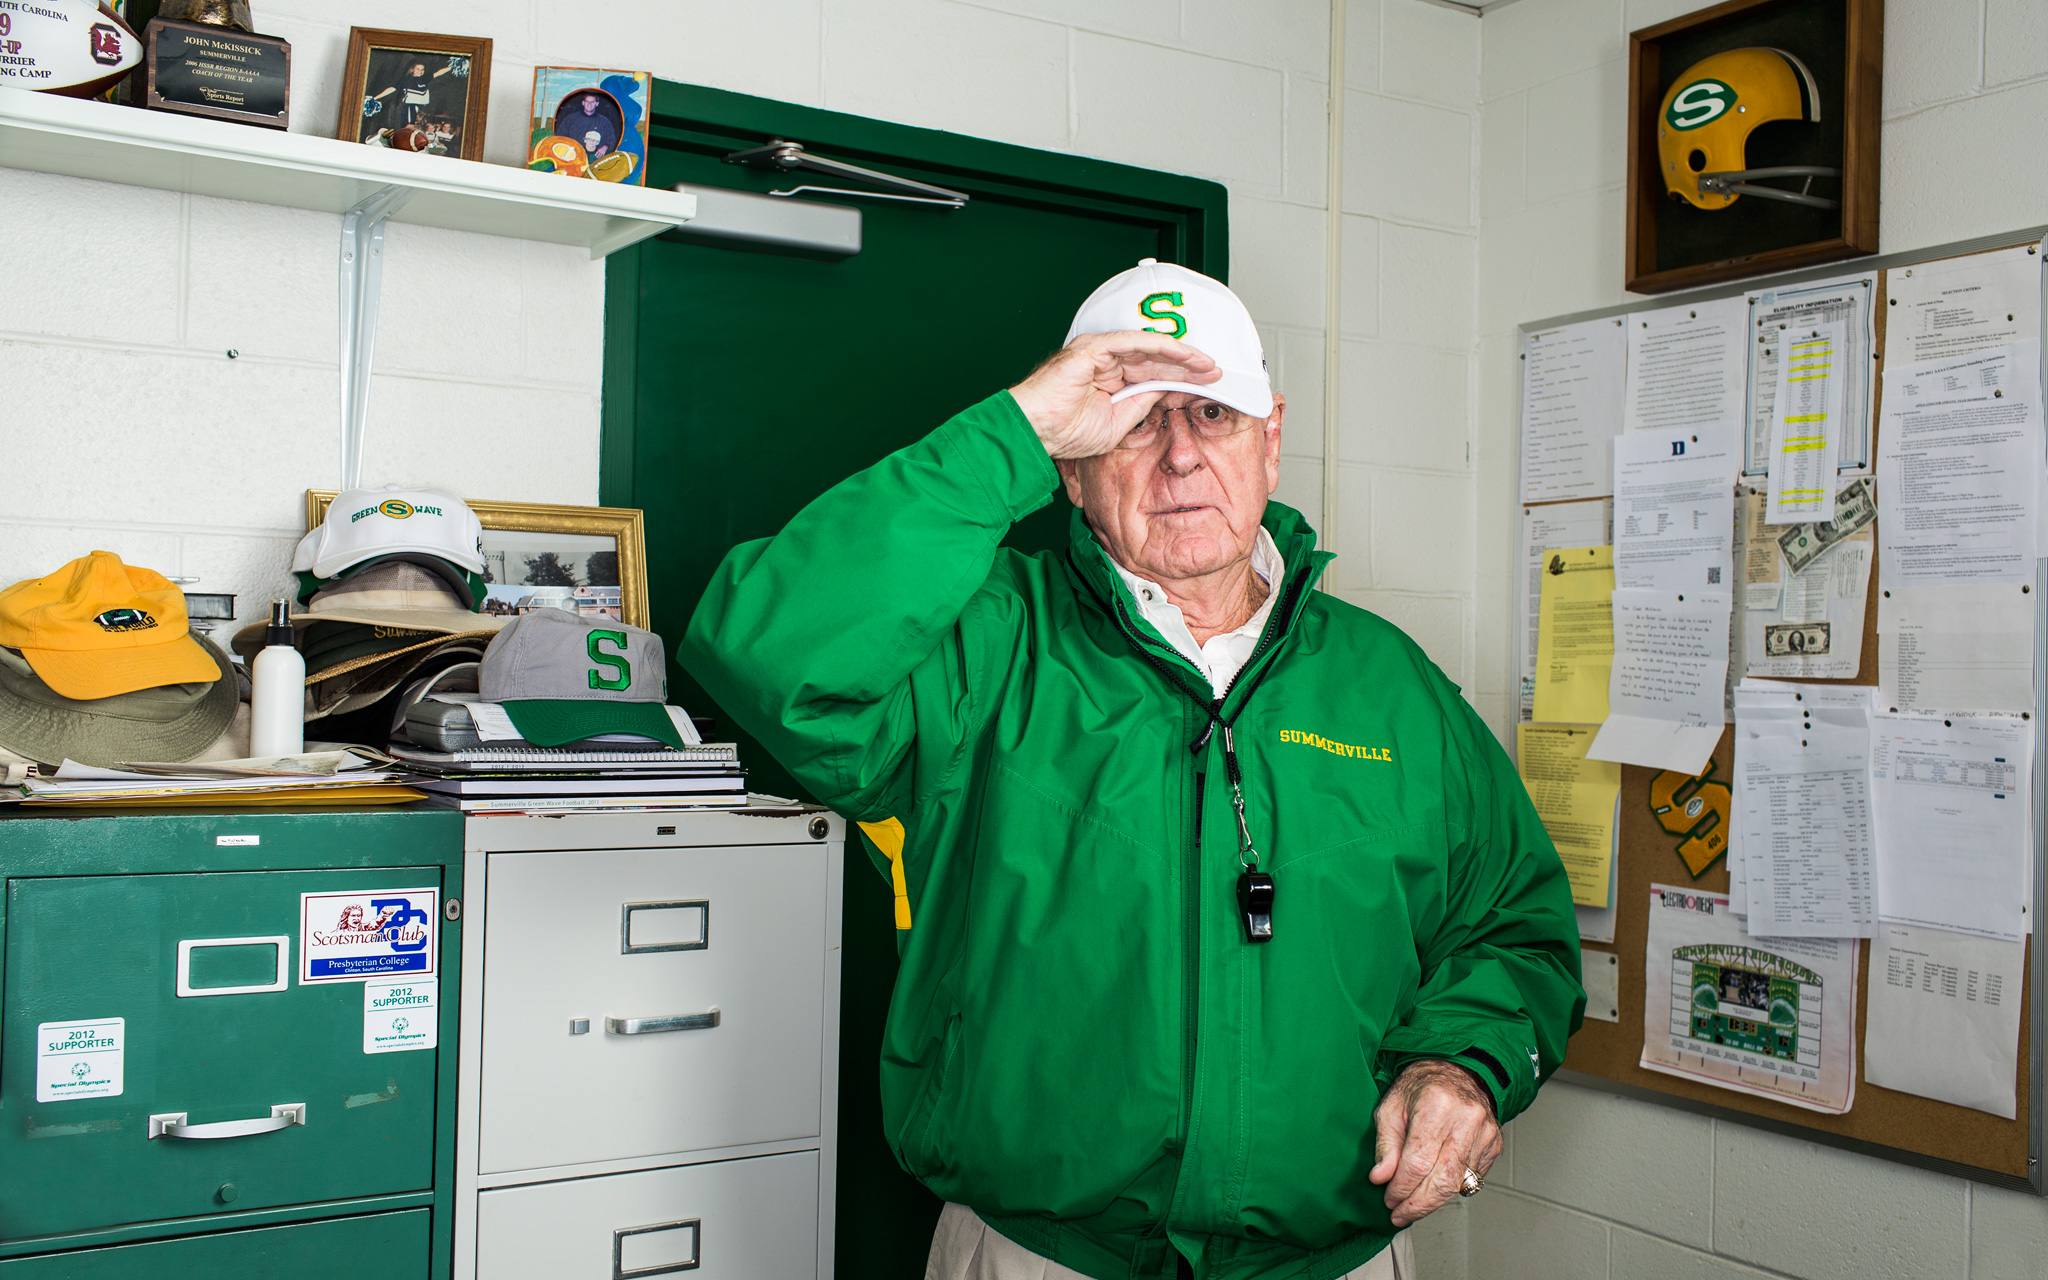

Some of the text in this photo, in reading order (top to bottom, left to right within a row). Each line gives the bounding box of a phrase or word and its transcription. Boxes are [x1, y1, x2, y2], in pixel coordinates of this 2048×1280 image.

[22, 3, 68, 22] CAROLINA
[0, 12, 11, 36] 9
[0, 40, 22, 54] -UP
[184, 36, 262, 56] JOHN McKISSICK
[200, 50, 246, 62] SUMMERVILLE
[20, 68, 52, 78] CAMP
[192, 68, 213, 78] COACH
[215, 64, 238, 73] REGION
[206, 92, 225, 100] Sports
[225, 94, 244, 103] Report
[1673, 82, 1726, 128] S
[1773, 297, 1843, 313] ELIGIBILITY INFORMATION
[1138, 291, 1188, 340] S
[1671, 440, 1686, 456] D
[351, 503, 443, 523] GREEN S WAVE
[586, 628, 631, 692] S
[1279, 730, 1392, 762] SUMMERVILLE
[1707, 834, 1722, 850] 406
[312, 925, 425, 947] Scotsman Club
[328, 956, 410, 970] Presbyterian College
[1676, 944, 1818, 984] SUMMERVILLE HIGH SCHOOL
[390, 988, 412, 997] 2012
[373, 995, 429, 1007] SUPPORTER
[1693, 1010, 1712, 1020] GUEST
[68, 1030, 95, 1040] 2012
[1776, 1028, 1794, 1038] HOME
[48, 1038, 114, 1051] SUPPORTER
[1743, 1042, 1755, 1051] BALL
